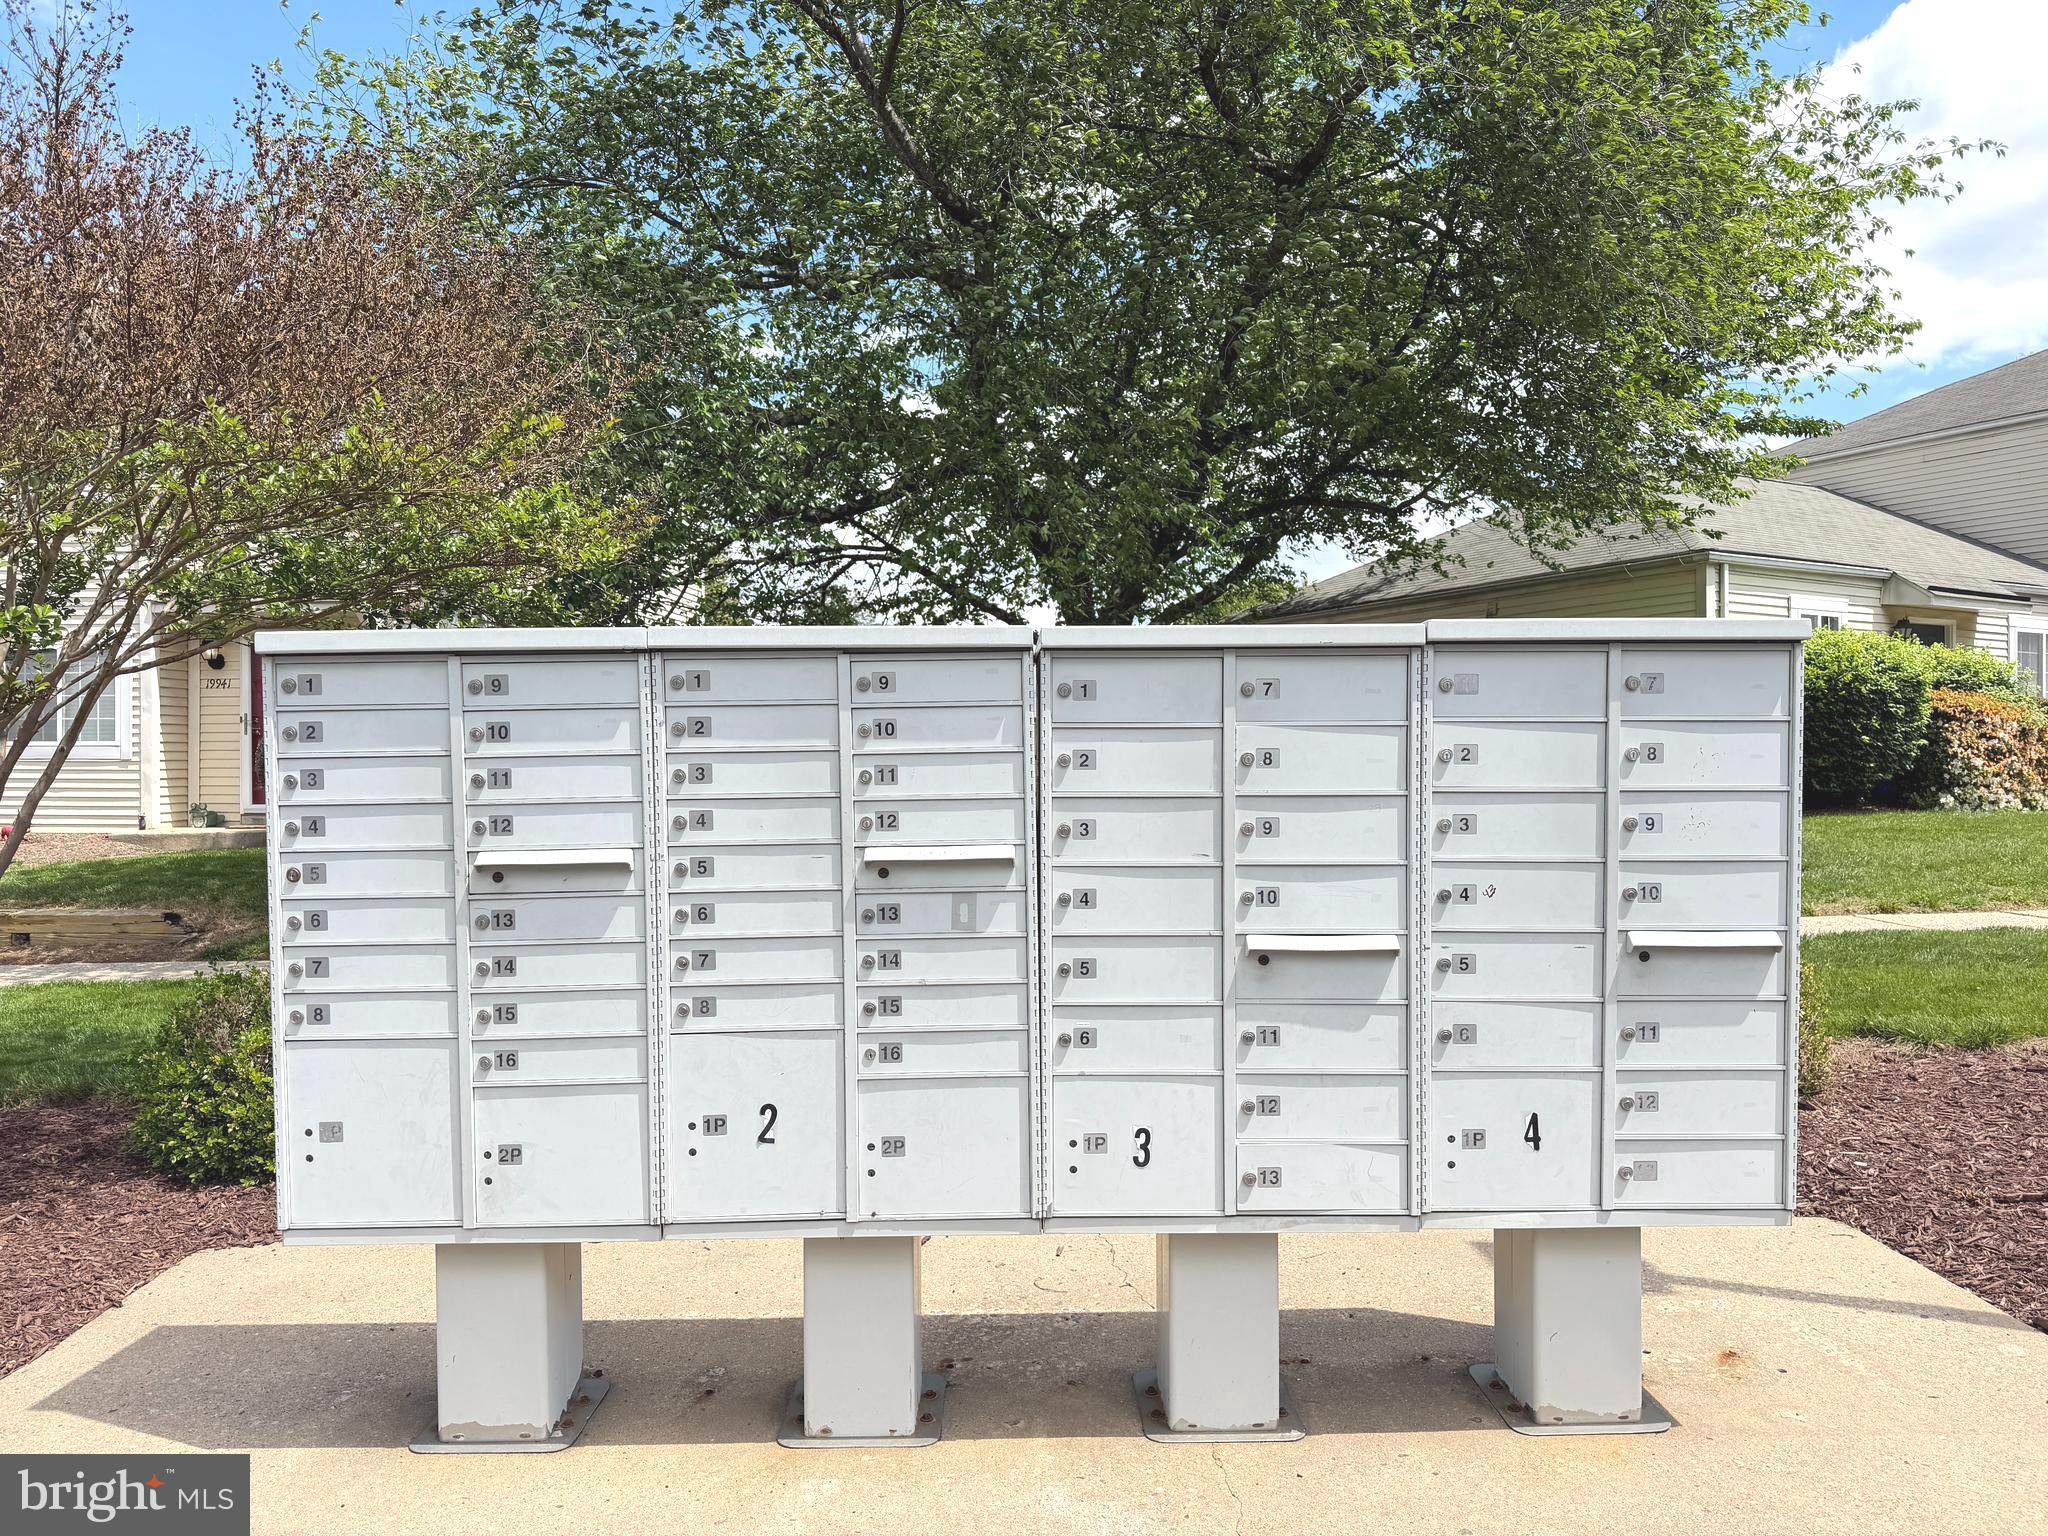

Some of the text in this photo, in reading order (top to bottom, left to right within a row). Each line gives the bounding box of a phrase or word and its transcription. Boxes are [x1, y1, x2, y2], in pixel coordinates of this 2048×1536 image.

[205, 678, 232, 689] 19941
[491, 678, 502, 693] 9
[878, 675, 889, 690] 9
[1262, 682, 1273, 697] 7
[305, 725, 316, 740] 2
[487, 725, 509, 740] 10
[694, 720, 705, 735] 2
[874, 722, 895, 737] 10
[1079, 753, 1089, 768] 2
[1262, 751, 1273, 766] 8
[1460, 747, 1471, 762] 2
[1647, 746, 1657, 761] 8
[307, 772, 318, 787] 3
[490, 771, 509, 786] 11
[695, 766, 706, 781] 3
[877, 768, 895, 783] 11
[308, 819, 319, 834] 4
[490, 818, 512, 833] 12
[695, 813, 707, 828] 4
[876, 814, 897, 829] 12
[1262, 820, 1273, 835] 9
[1459, 817, 1470, 832] 3
[1645, 816, 1655, 831] 9
[1079, 822, 1090, 837] 3
[310, 866, 320, 881] 5
[697, 860, 708, 875] 5
[1079, 892, 1090, 907] 4
[1257, 889, 1277, 905] 10
[1459, 887, 1470, 902] 4
[1639, 885, 1660, 901] 10
[310, 913, 321, 928] 6
[493, 912, 514, 928] 13
[697, 906, 708, 921] 6
[878, 906, 899, 921] 13
[311, 960, 323, 975] 7
[494, 959, 515, 974] 14
[698, 953, 709, 968] 7
[879, 953, 900, 968] 14
[1459, 957, 1469, 972] 5
[1079, 961, 1090, 976] 5
[494, 1006, 516, 1021] 15
[699, 999, 710, 1015] 8
[879, 999, 900, 1014] 15
[313, 1007, 324, 1022] 8
[1079, 1031, 1090, 1046] 6
[1258, 1029, 1277, 1044] 11
[1638, 1025, 1656, 1040] 11
[496, 1053, 516, 1068] 16
[880, 1046, 901, 1061] 16
[1258, 1098, 1278, 1114] 12
[1637, 1095, 1656, 1109] 12
[703, 1117, 726, 1133] 1P
[757, 1103, 778, 1144] 2
[1523, 1112, 1541, 1151] 4
[882, 1139, 905, 1155] 2P
[1084, 1136, 1106, 1151] 1P
[1463, 1132, 1485, 1147] 1P
[499, 1147, 522, 1163] 2P
[1132, 1127, 1151, 1168] 3
[1259, 1169, 1280, 1185] 13
